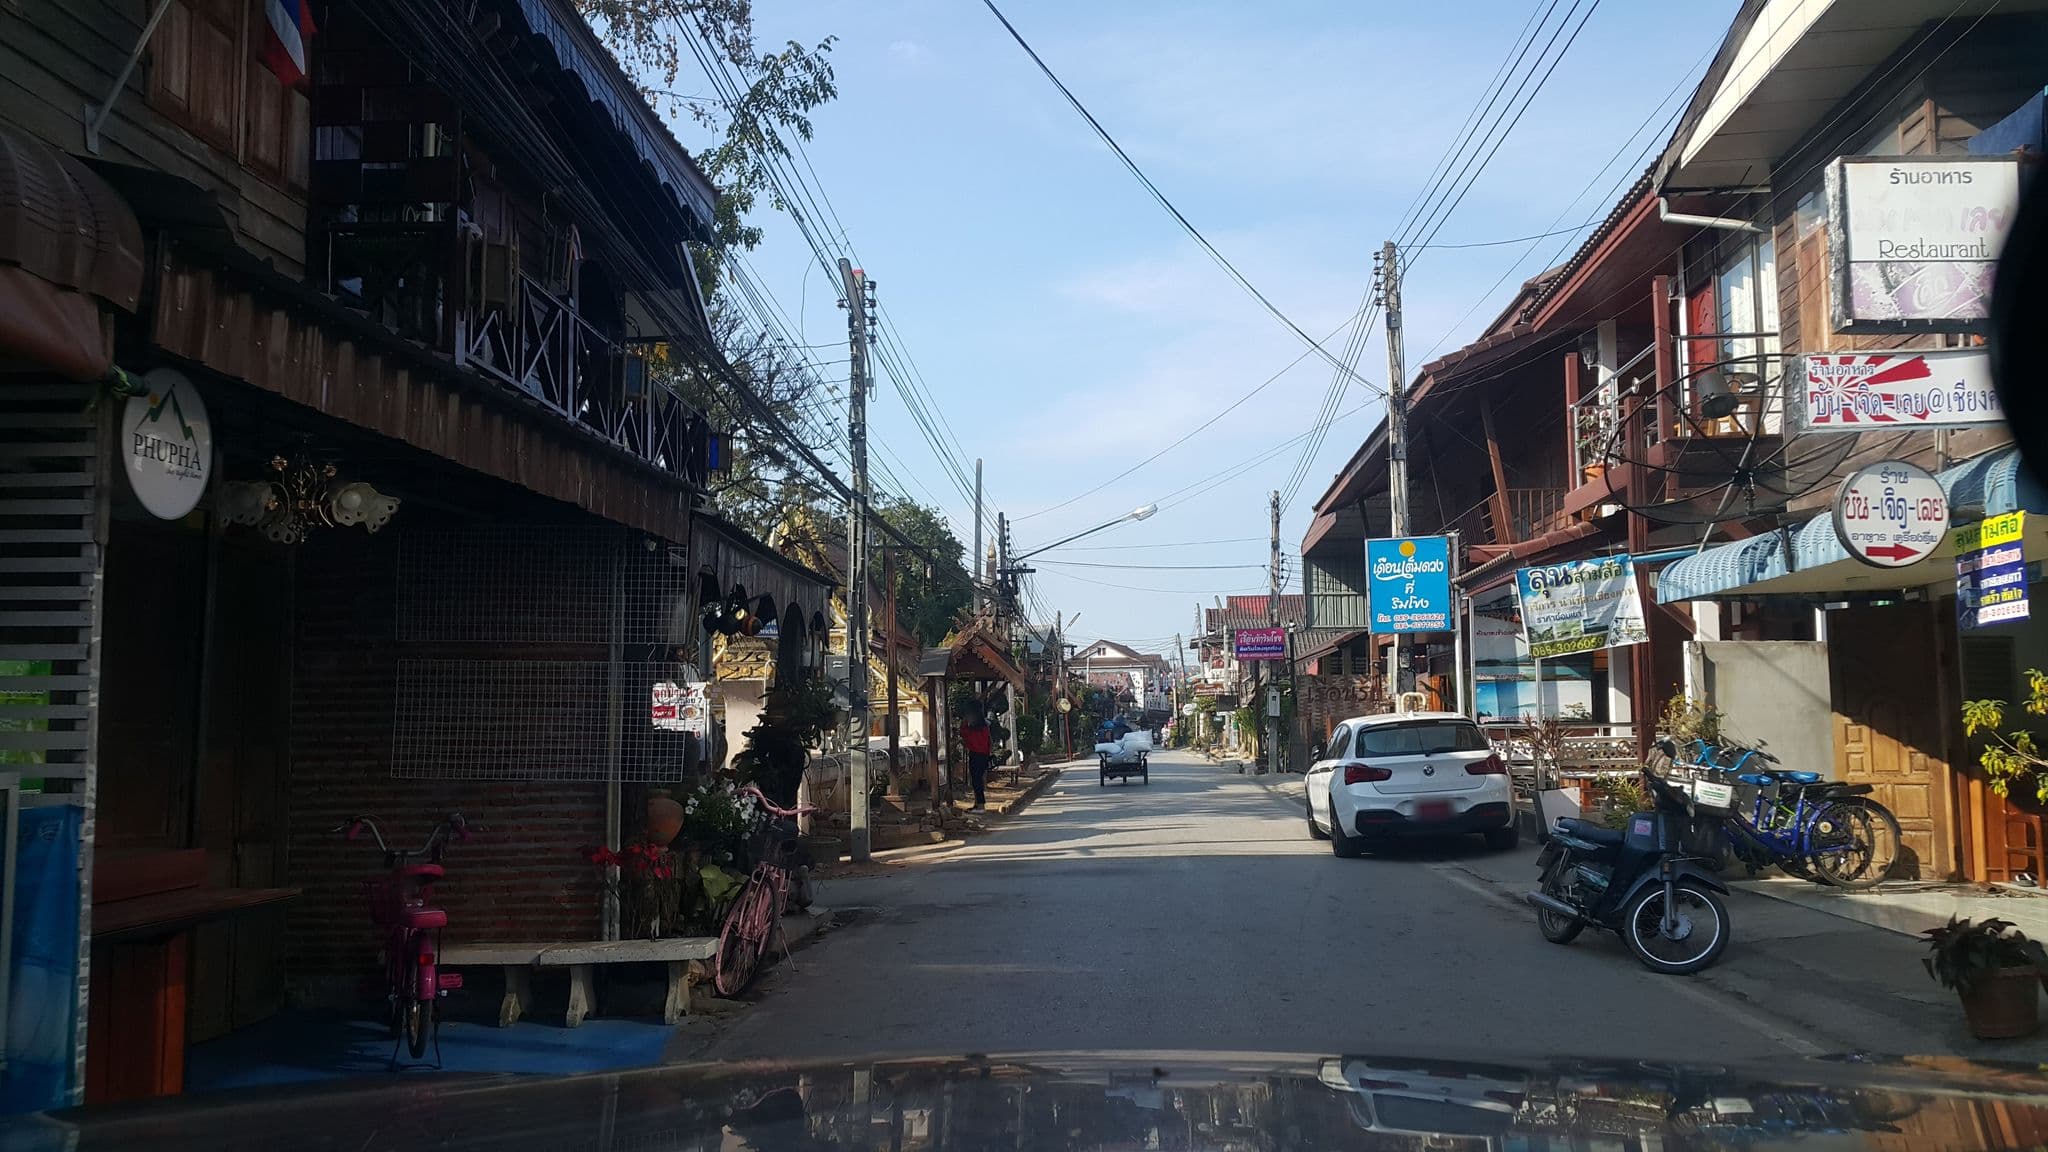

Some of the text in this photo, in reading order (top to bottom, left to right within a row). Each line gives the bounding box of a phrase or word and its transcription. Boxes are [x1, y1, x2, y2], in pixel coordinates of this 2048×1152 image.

[1889, 167, 1972, 184] ร้านอาหาร
[1879, 237, 1990, 259] Restaurant
[1811, 361, 1875, 381] ร้านอาหาร
[133, 433, 202, 471] PHUPHA
[1880, 466, 1908, 484] ร้าน
[1373, 556, 1444, 581] เดือนเต็มดวง
[1391, 596, 1430, 610] ริมโขง
